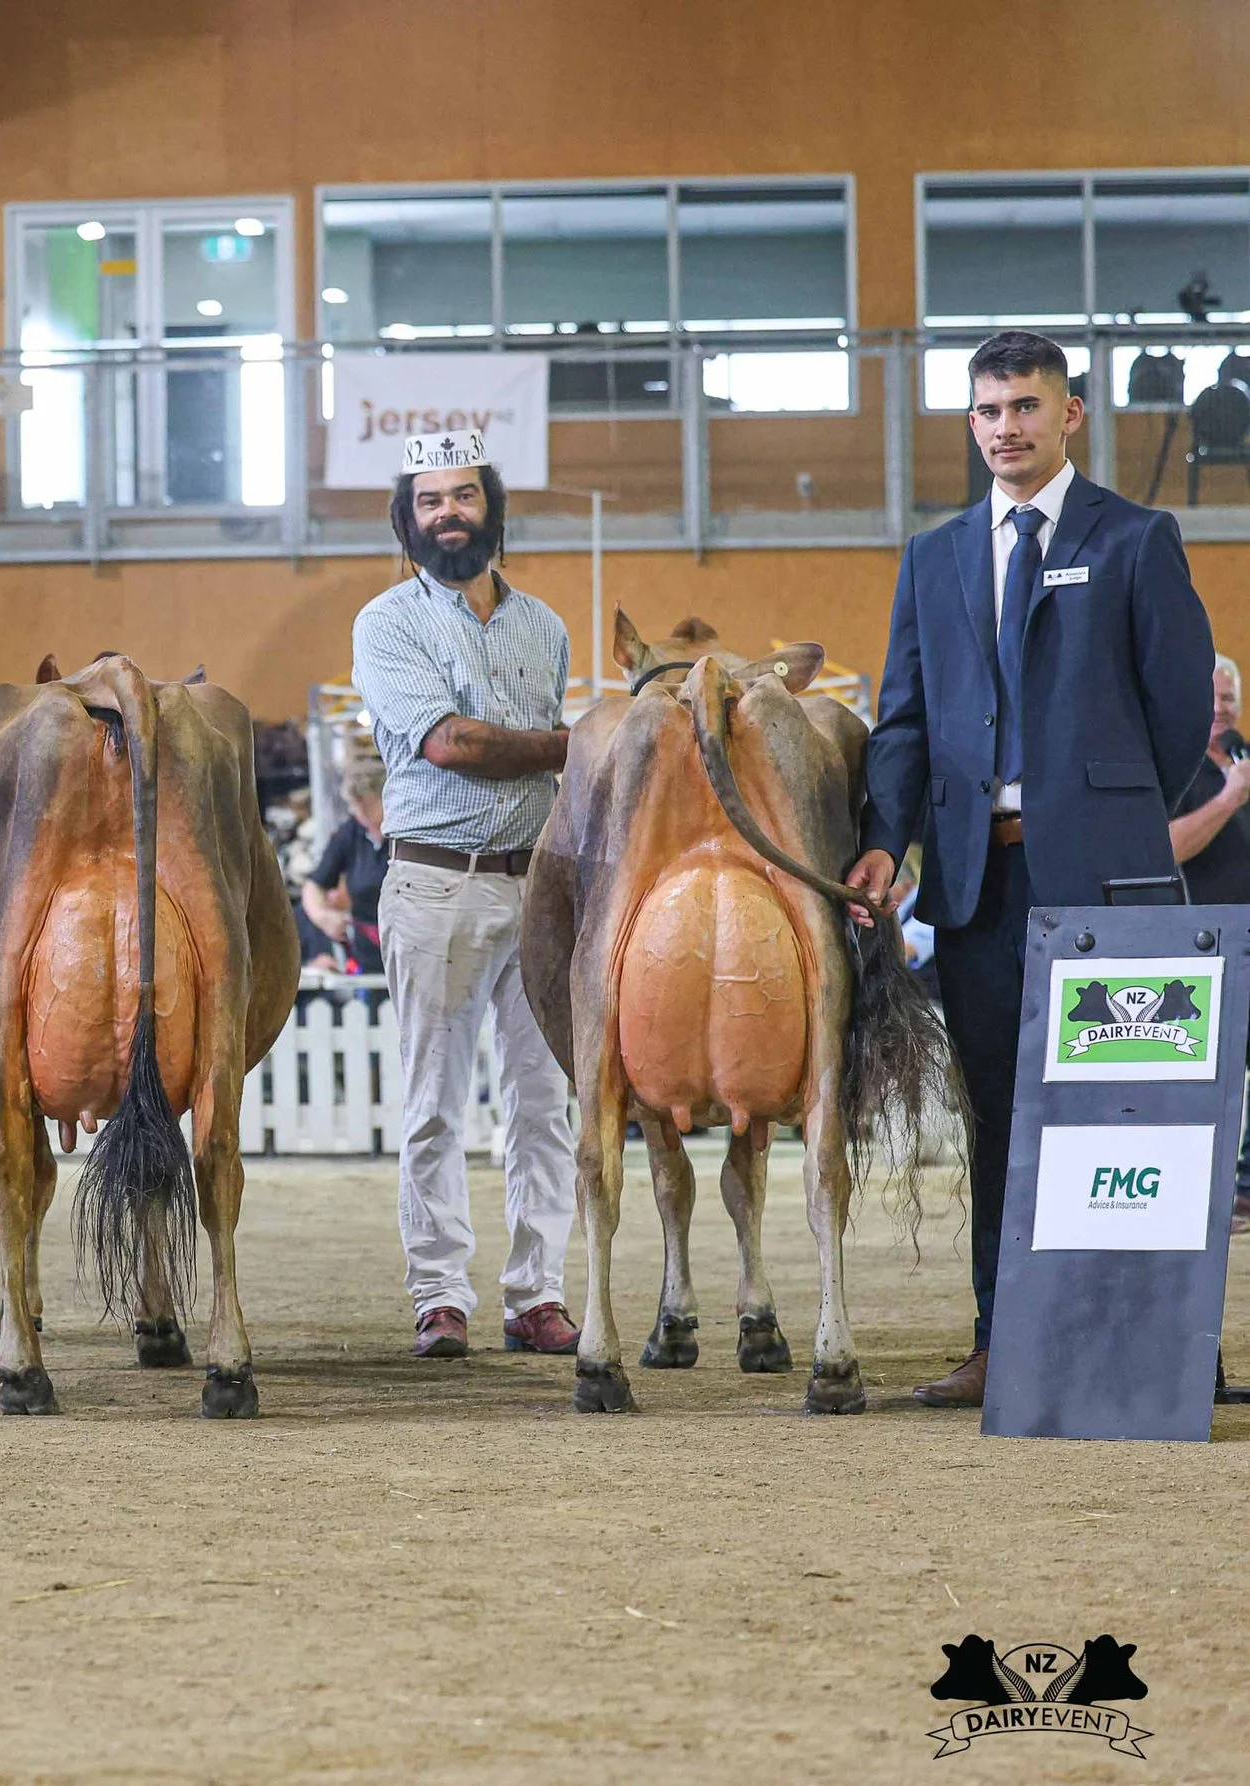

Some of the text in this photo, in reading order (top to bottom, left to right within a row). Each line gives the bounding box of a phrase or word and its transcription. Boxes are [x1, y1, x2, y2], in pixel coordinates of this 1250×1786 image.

[427, 449, 470, 467] SEMEX
[1126, 992, 1147, 1005] NZ
[1090, 1167, 1162, 1199] FMG
[1088, 1200, 1147, 1210] Advice & Insurance
